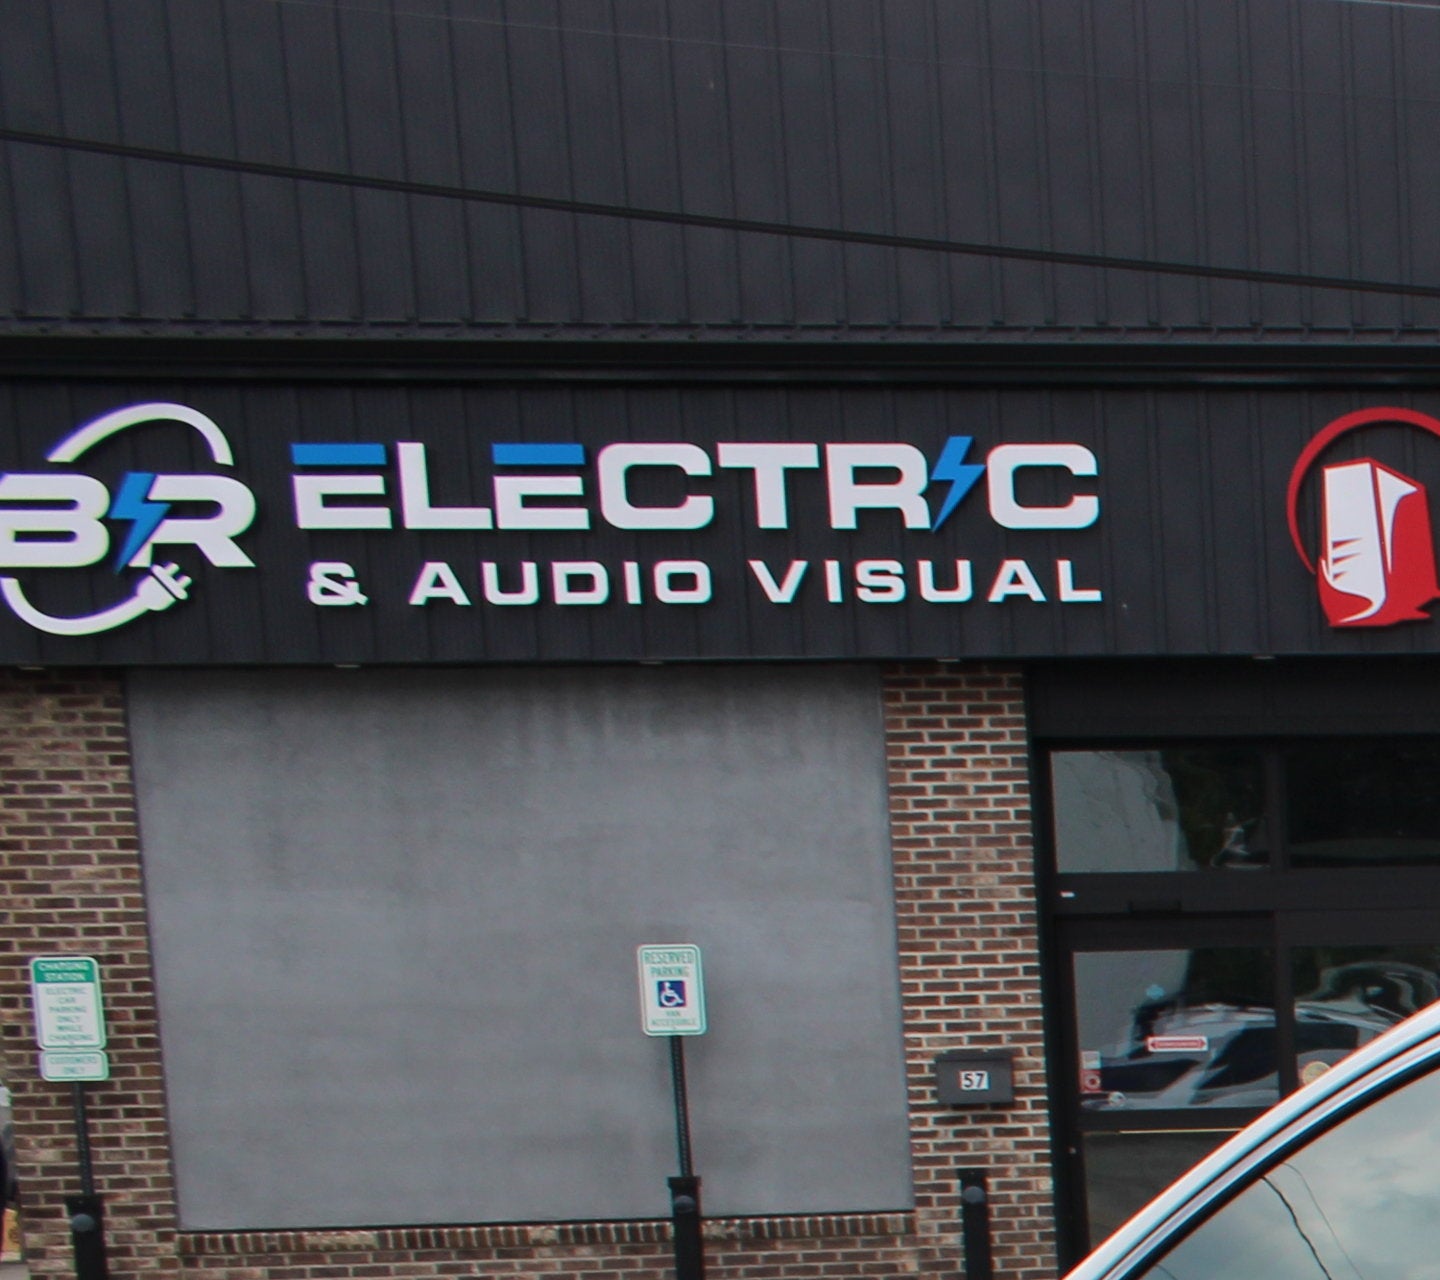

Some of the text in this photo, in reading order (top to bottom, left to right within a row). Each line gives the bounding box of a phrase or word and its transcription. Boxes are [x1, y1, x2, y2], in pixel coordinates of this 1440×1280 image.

[307, 559, 1103, 606] & AUDIO VISUAL
[644, 951, 694, 964] RESERVED
[650, 966, 690, 977] PARKING
[963, 1072, 985, 1089] 57
